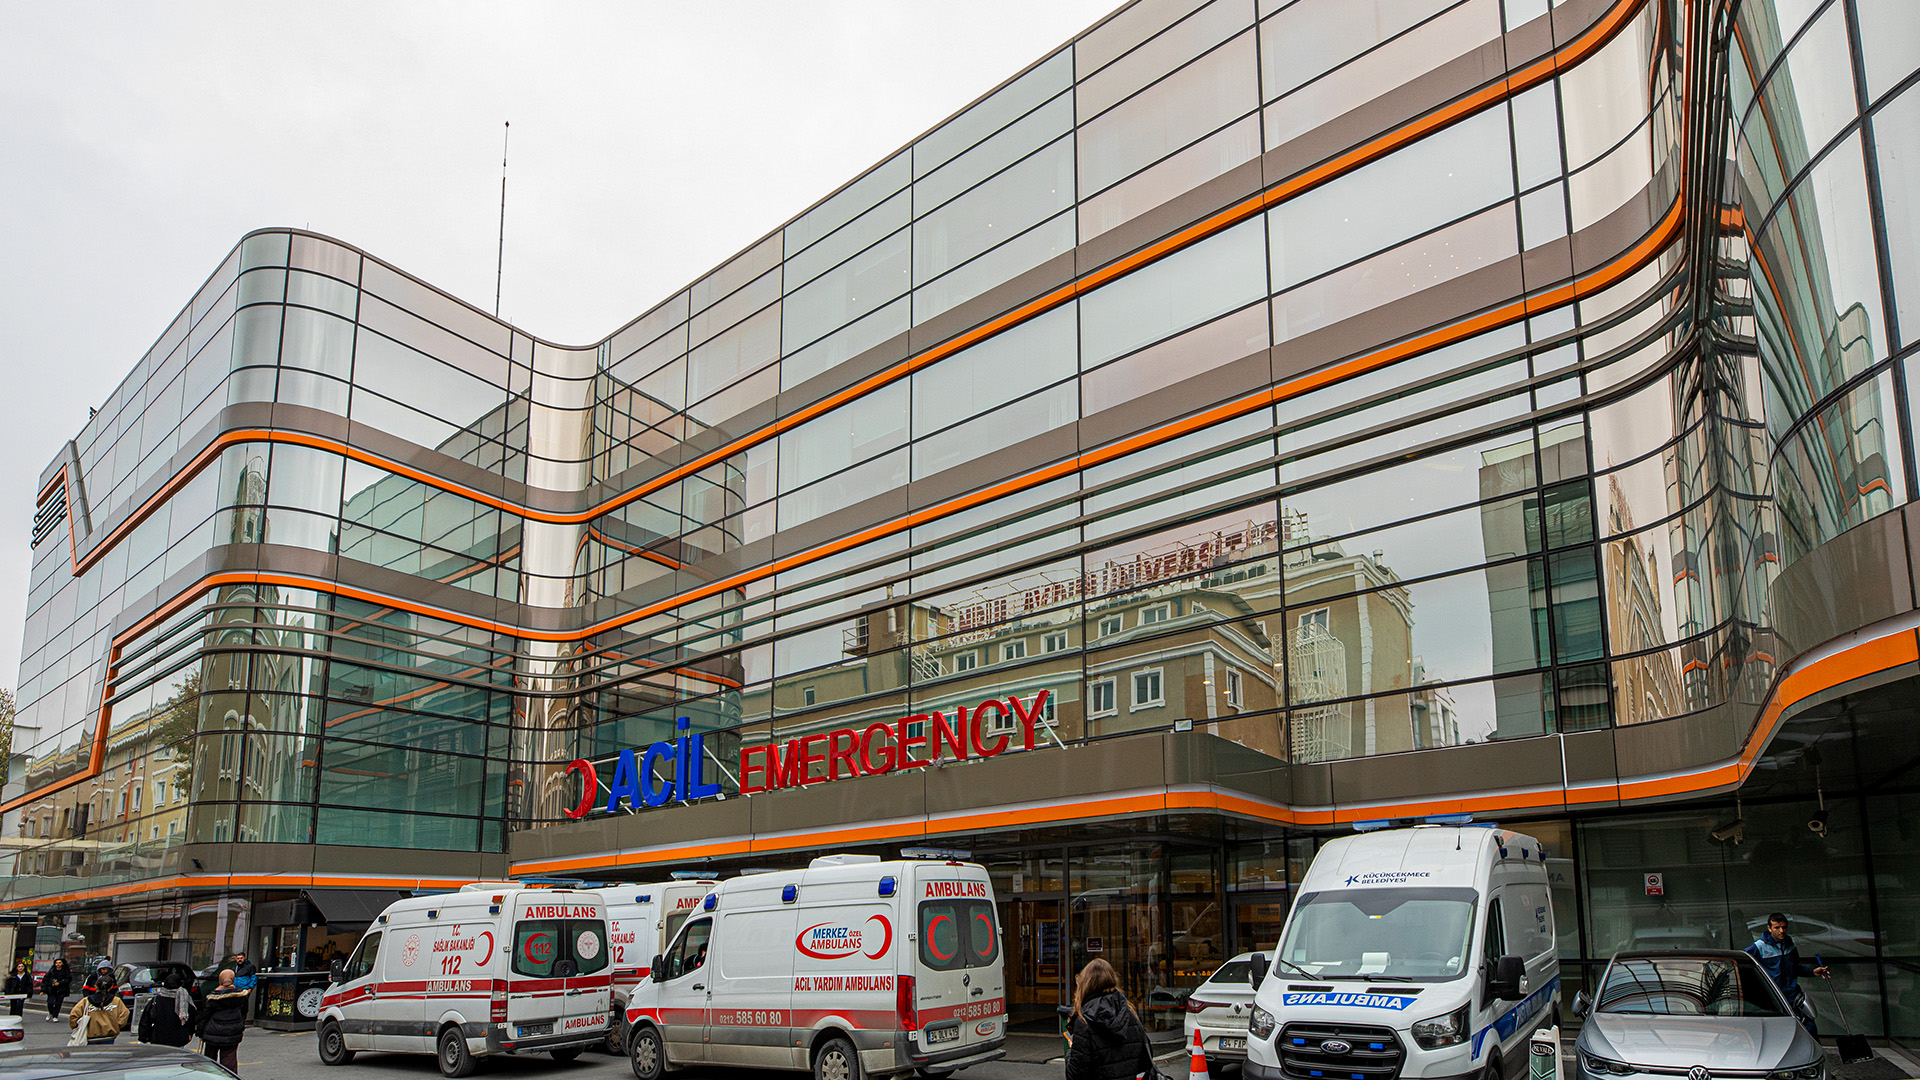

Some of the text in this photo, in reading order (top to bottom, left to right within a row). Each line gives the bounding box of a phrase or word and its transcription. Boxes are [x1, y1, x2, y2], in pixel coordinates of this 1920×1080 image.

[607, 689, 1051, 813] ACİL EMERGENCY
[925, 882, 986, 898] AMBULANS
[525, 906, 597, 919] AMBULANS
[812, 927, 848, 939] MERKEZ
[533, 942, 552, 955] 112
[810, 938, 862, 950] AMBULANS
[612, 946, 624, 963] 12
[441, 955, 461, 975] 112
[427, 980, 472, 992] AMBULANS
[813, 976, 843, 991] YARDIM
[845, 975, 894, 991] AMBULANSI
[953, 1001, 1000, 1018] 0212 585 60 80
[564, 1014, 605, 1029] AMBULANS
[720, 1011, 782, 1025] 0212 585 60 80
[1224, 1039, 1231, 1047] 34
[1326, 1042, 1343, 1050] Ford
